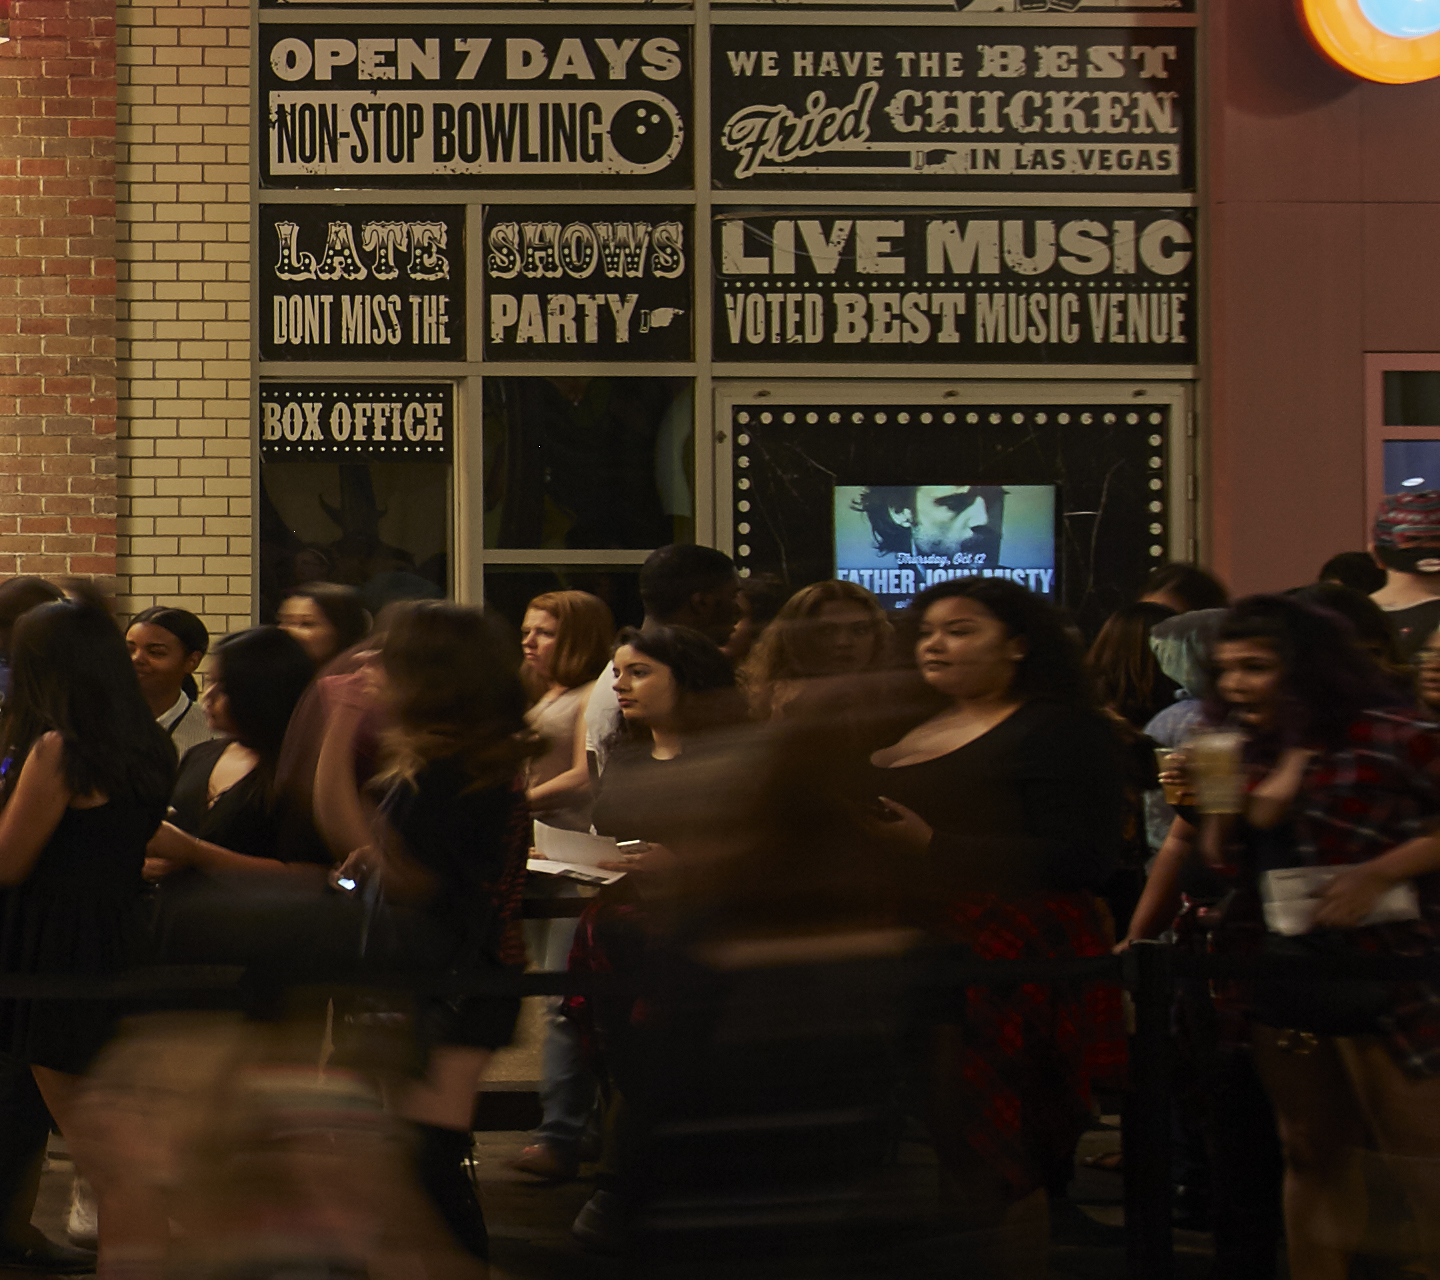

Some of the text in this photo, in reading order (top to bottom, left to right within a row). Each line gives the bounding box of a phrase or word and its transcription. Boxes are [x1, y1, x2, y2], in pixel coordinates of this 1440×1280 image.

[270, 37, 682, 81] OPEN 7 DAYS
[726, 45, 1177, 79] WE HAVE THE BEST
[277, 102, 603, 164] NON-STOP BOWLING
[721, 80, 1179, 179] Fried CHICKEN
[970, 148, 1172, 171] IN LAS VEGAS
[274, 220, 686, 282] LATE SHOWS
[721, 219, 1193, 276] LIVE MUSIC
[273, 293, 639, 345] DONT MISS THE PARTY
[724, 292, 1188, 344] VOTED BEST MUSIC VENUE
[261, 402, 443, 442] BOX OFFICE
[896, 552, 950, 567] Thursday,
